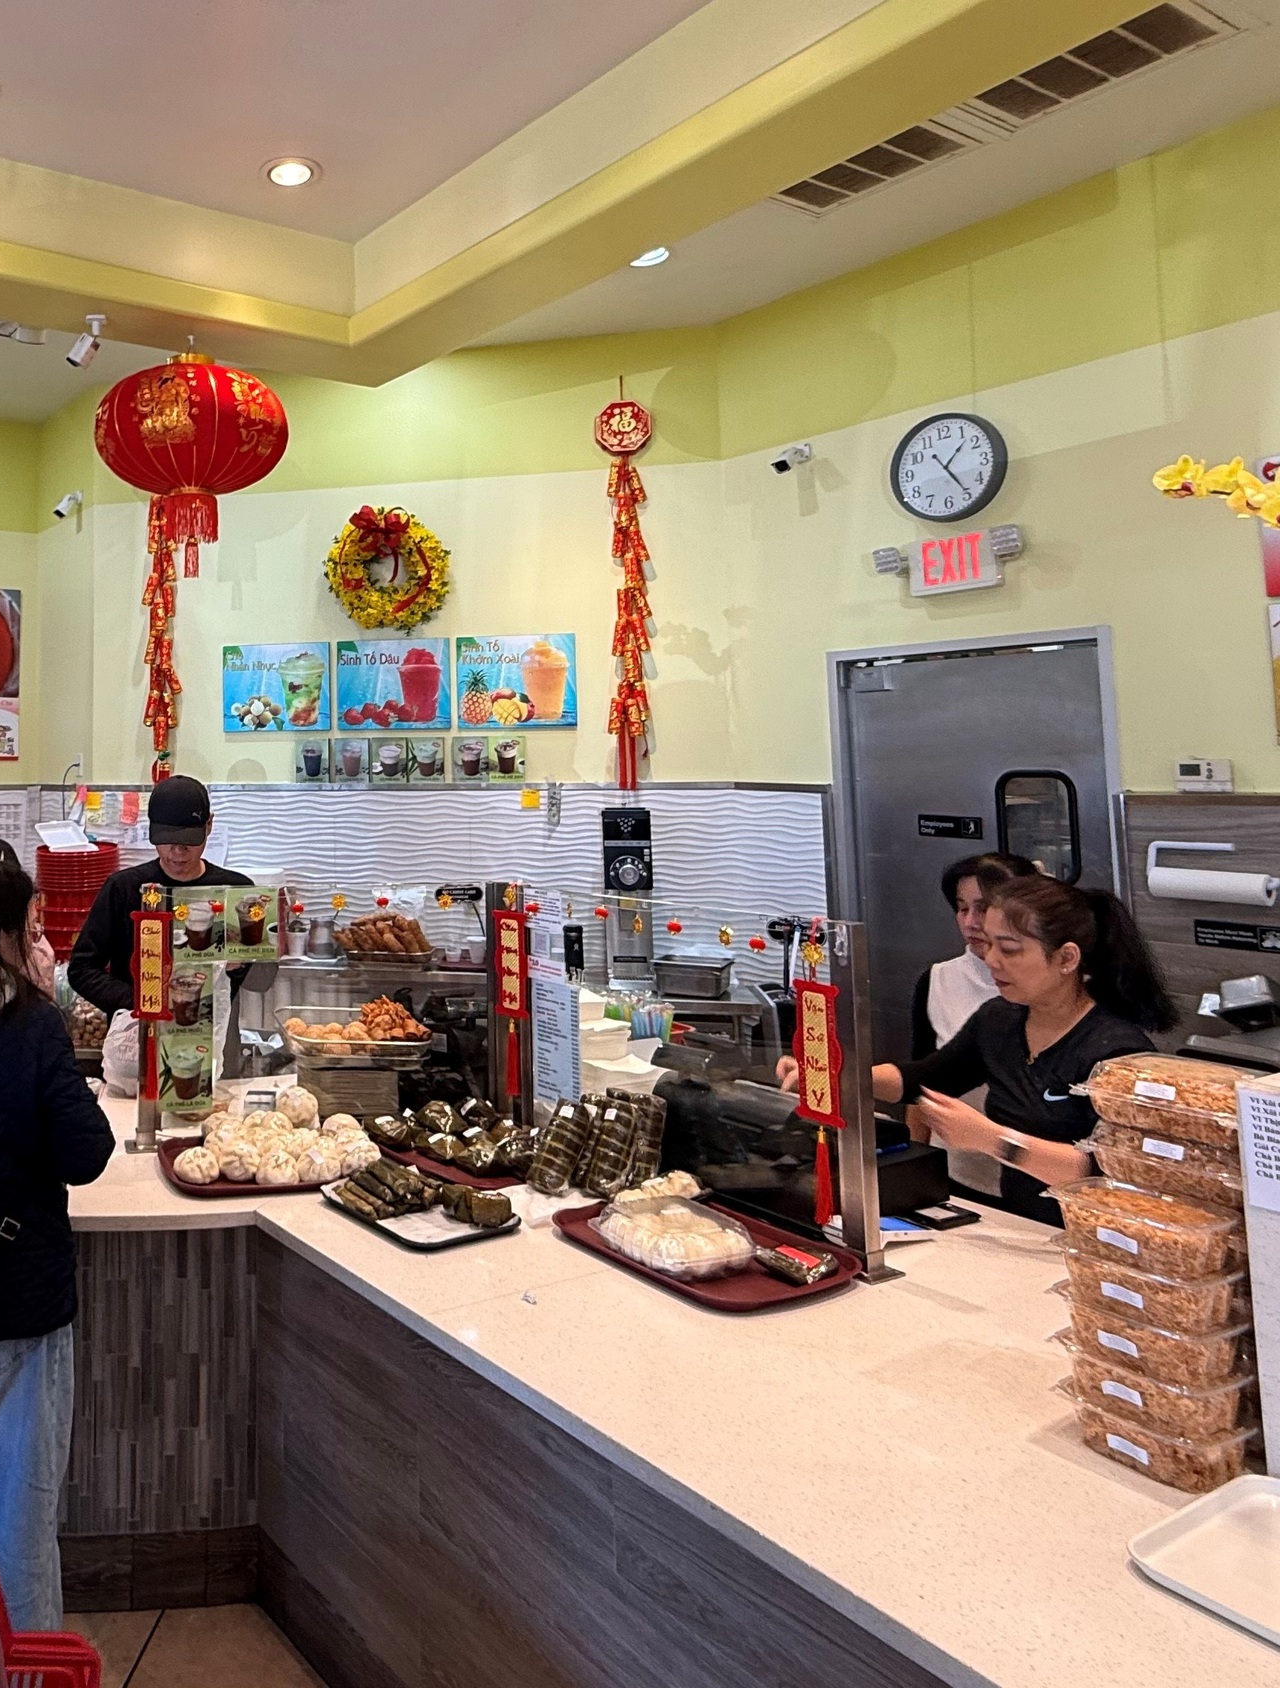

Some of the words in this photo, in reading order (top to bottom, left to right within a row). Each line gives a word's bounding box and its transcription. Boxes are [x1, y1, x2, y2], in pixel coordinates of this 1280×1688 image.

[936, 425, 951, 441] 12
[958, 426, 966, 439] 1
[921, 435, 933, 450] 11
[970, 435, 981, 449] 2
[910, 451, 924, 465] 10
[979, 452, 990, 466] 3
[905, 470, 914, 483] 9
[974, 471, 984, 485] 4
[912, 485, 921, 499] 8
[962, 487, 972, 501] 5
[925, 494, 935, 508] 7
[943, 496, 954, 510] 6
[921, 531, 983, 587] EXIT
[486, 639, 500, 652] Tố
[340, 653, 361, 666] Sinh
[365, 651, 376, 665] Tố
[380, 653, 400, 665] Dâu
[920, 819, 954, 828] Employees
[920, 827, 935, 835] Only
